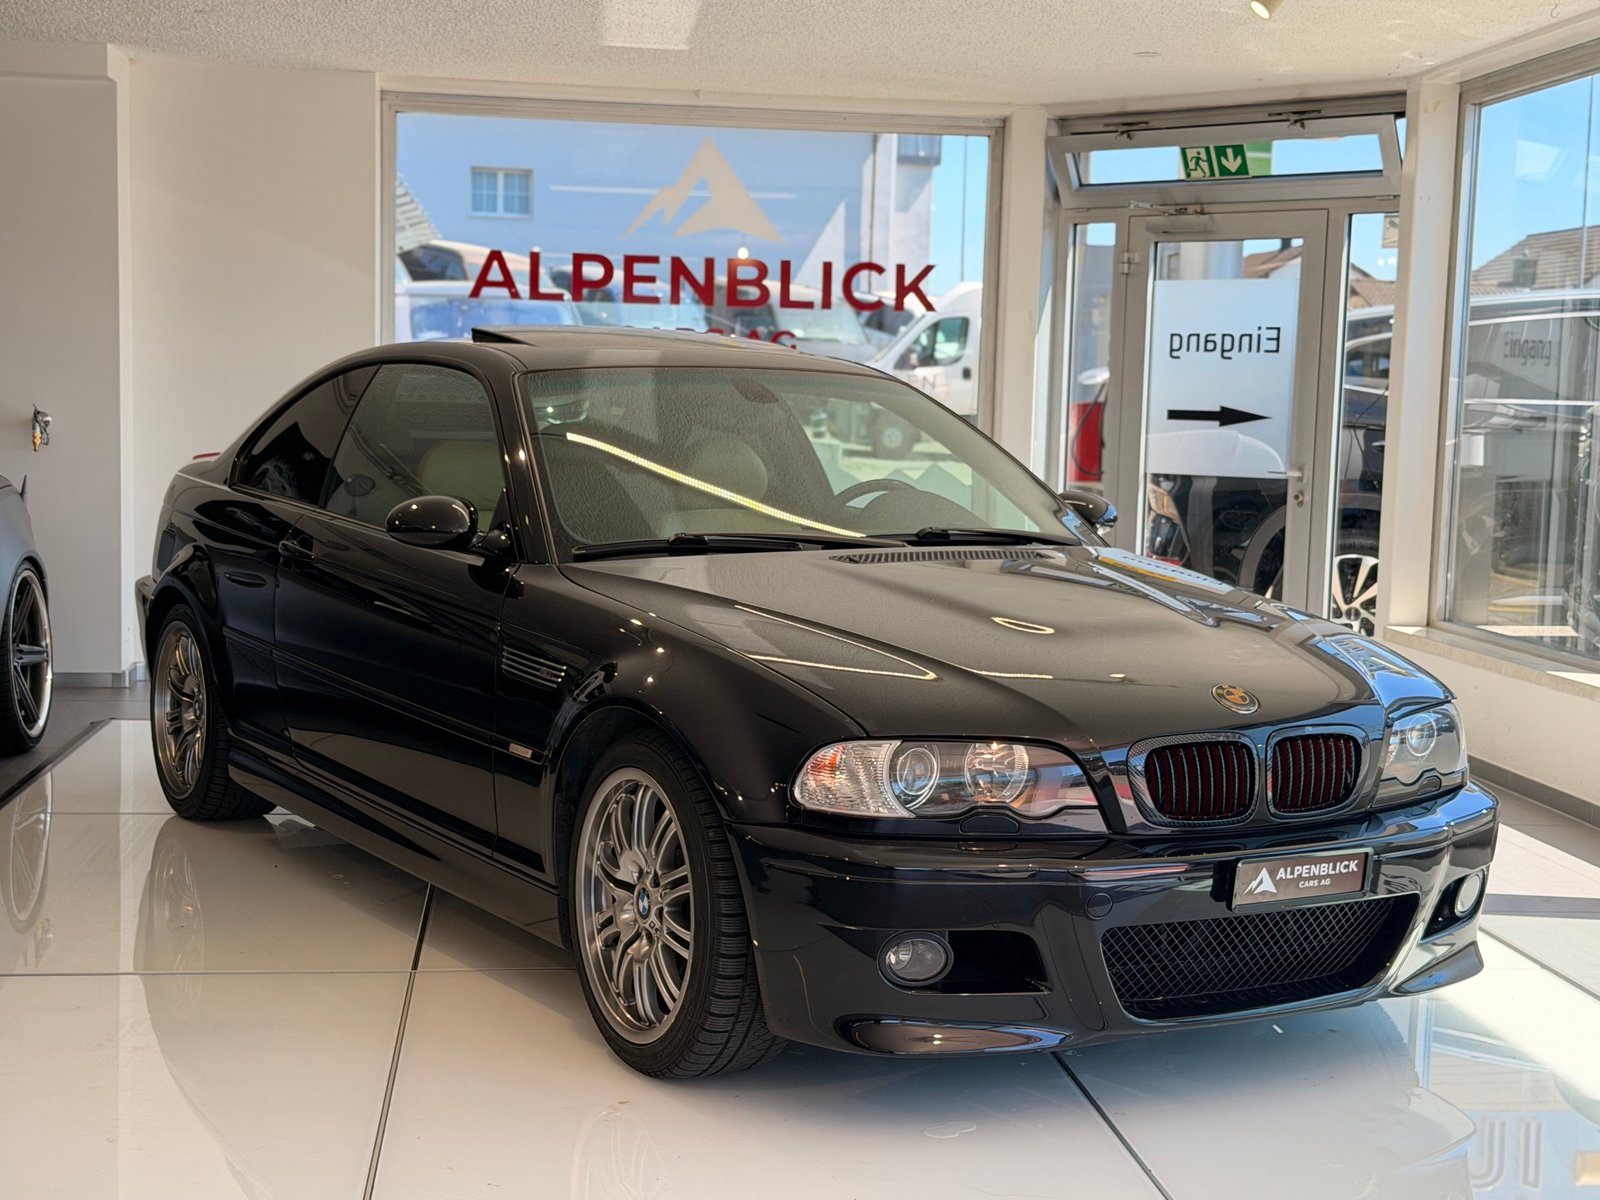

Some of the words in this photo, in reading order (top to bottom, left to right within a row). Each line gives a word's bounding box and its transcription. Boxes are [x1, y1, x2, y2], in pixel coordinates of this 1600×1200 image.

[468, 249, 937, 313] ALPENBLICK
[1276, 860, 1359, 880] ALPENBLICK
[1299, 879, 1318, 889] CARS
[1320, 878, 1331, 886] AG
